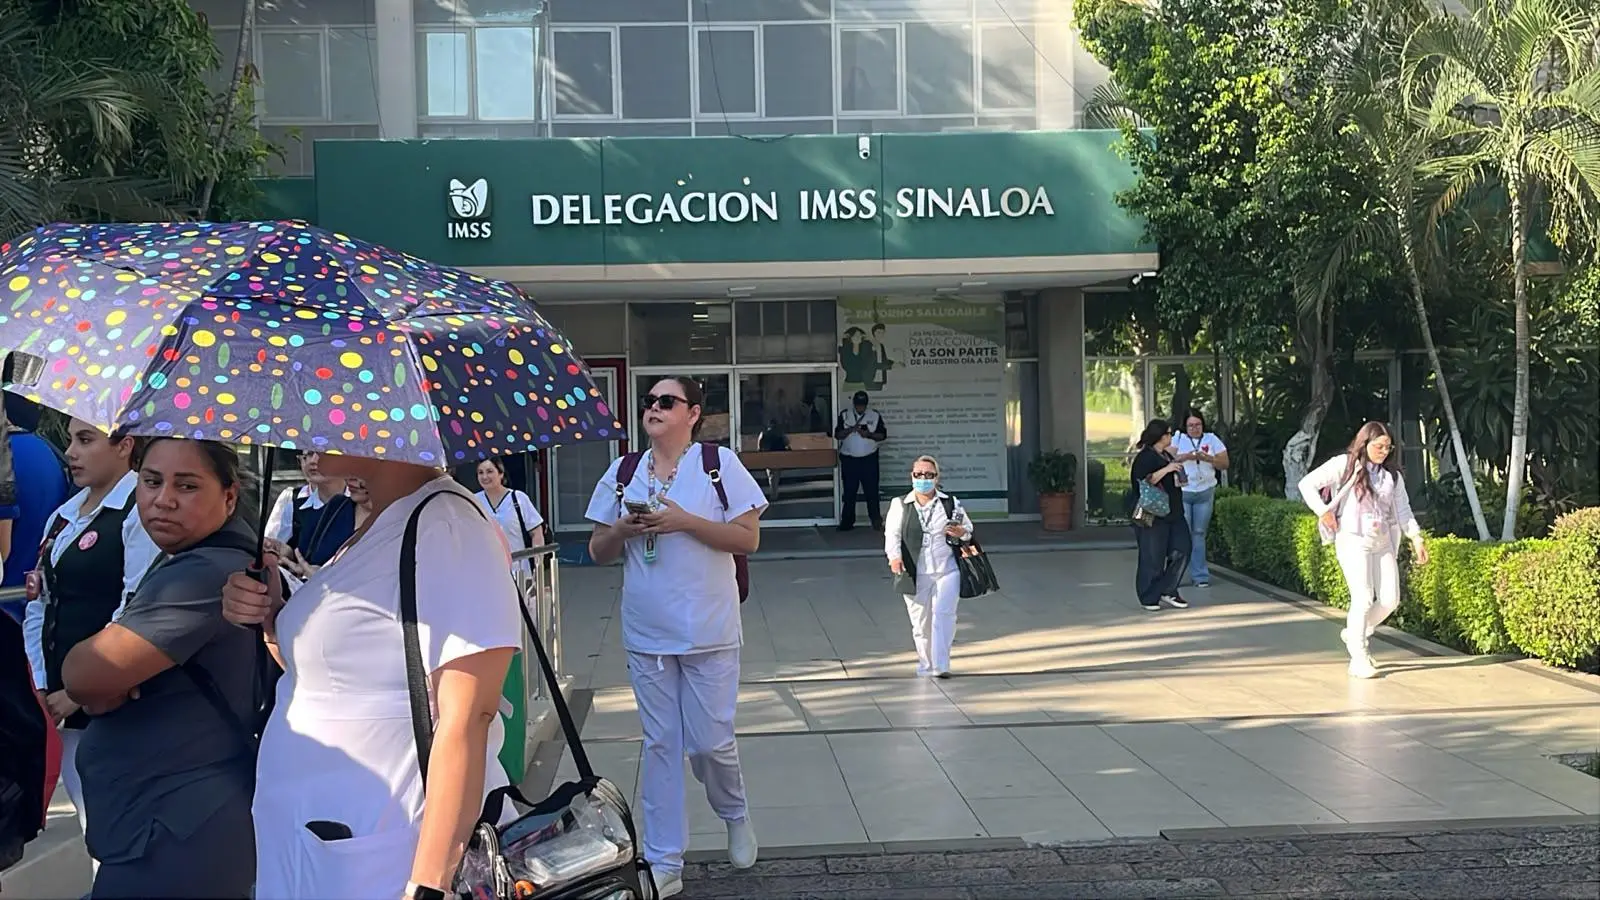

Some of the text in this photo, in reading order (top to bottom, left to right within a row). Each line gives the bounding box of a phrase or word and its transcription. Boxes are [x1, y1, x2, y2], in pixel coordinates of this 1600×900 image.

[799, 188, 878, 220] IMSS
[896, 186, 1055, 218] SINALOA
[448, 222, 492, 239] IMSS
[855, 308, 914, 319] ENORNO
[909, 337, 943, 347] PARA
[910, 346, 999, 358] YA SON PARTE
